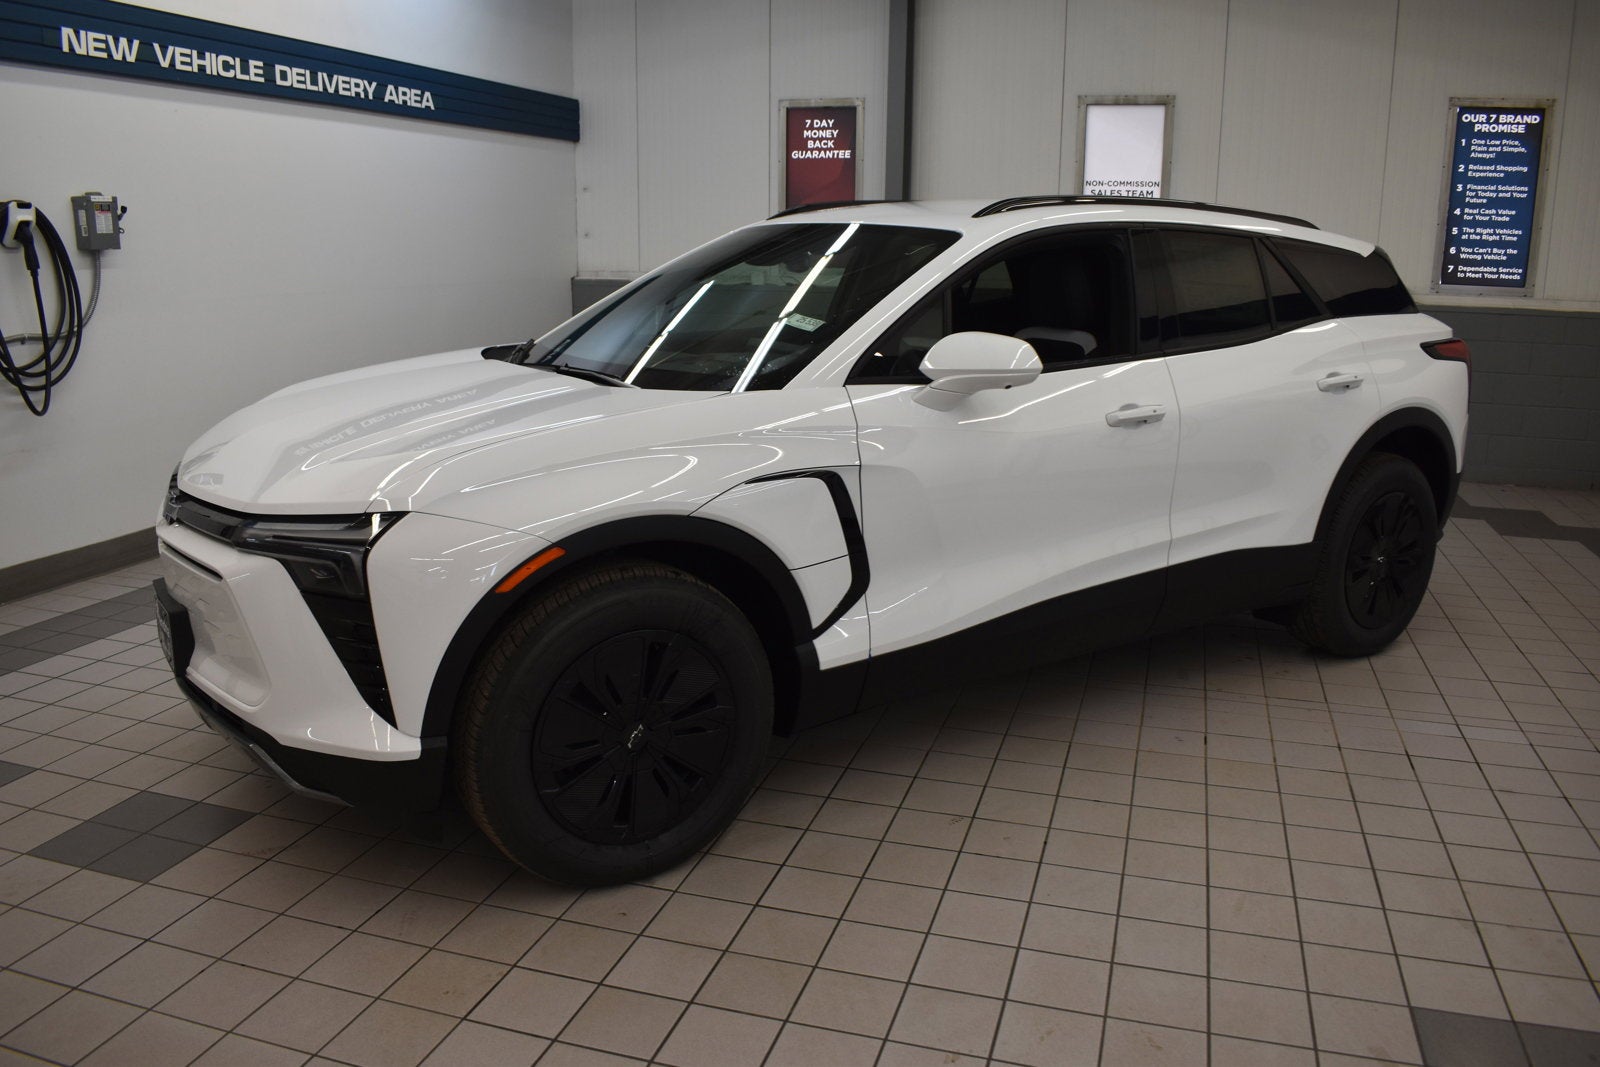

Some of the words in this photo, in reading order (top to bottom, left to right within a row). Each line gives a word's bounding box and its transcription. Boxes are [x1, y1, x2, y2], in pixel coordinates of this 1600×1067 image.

[60, 26, 140, 63] NEW
[153, 43, 265, 84] VEHICLE
[275, 64, 378, 100] DELIVERY
[384, 85, 436, 110] AREA
[805, 119, 811, 127] 7
[813, 119, 835, 127] DAY
[1462, 114, 1487, 122] OUR
[1489, 114, 1496, 123] 7
[1499, 114, 1540, 124] BRAND
[1474, 124, 1526, 133] PROMISE
[803, 130, 839, 138] MONEY
[807, 140, 834, 148] BACK
[791, 150, 851, 159] GUARANTEE
